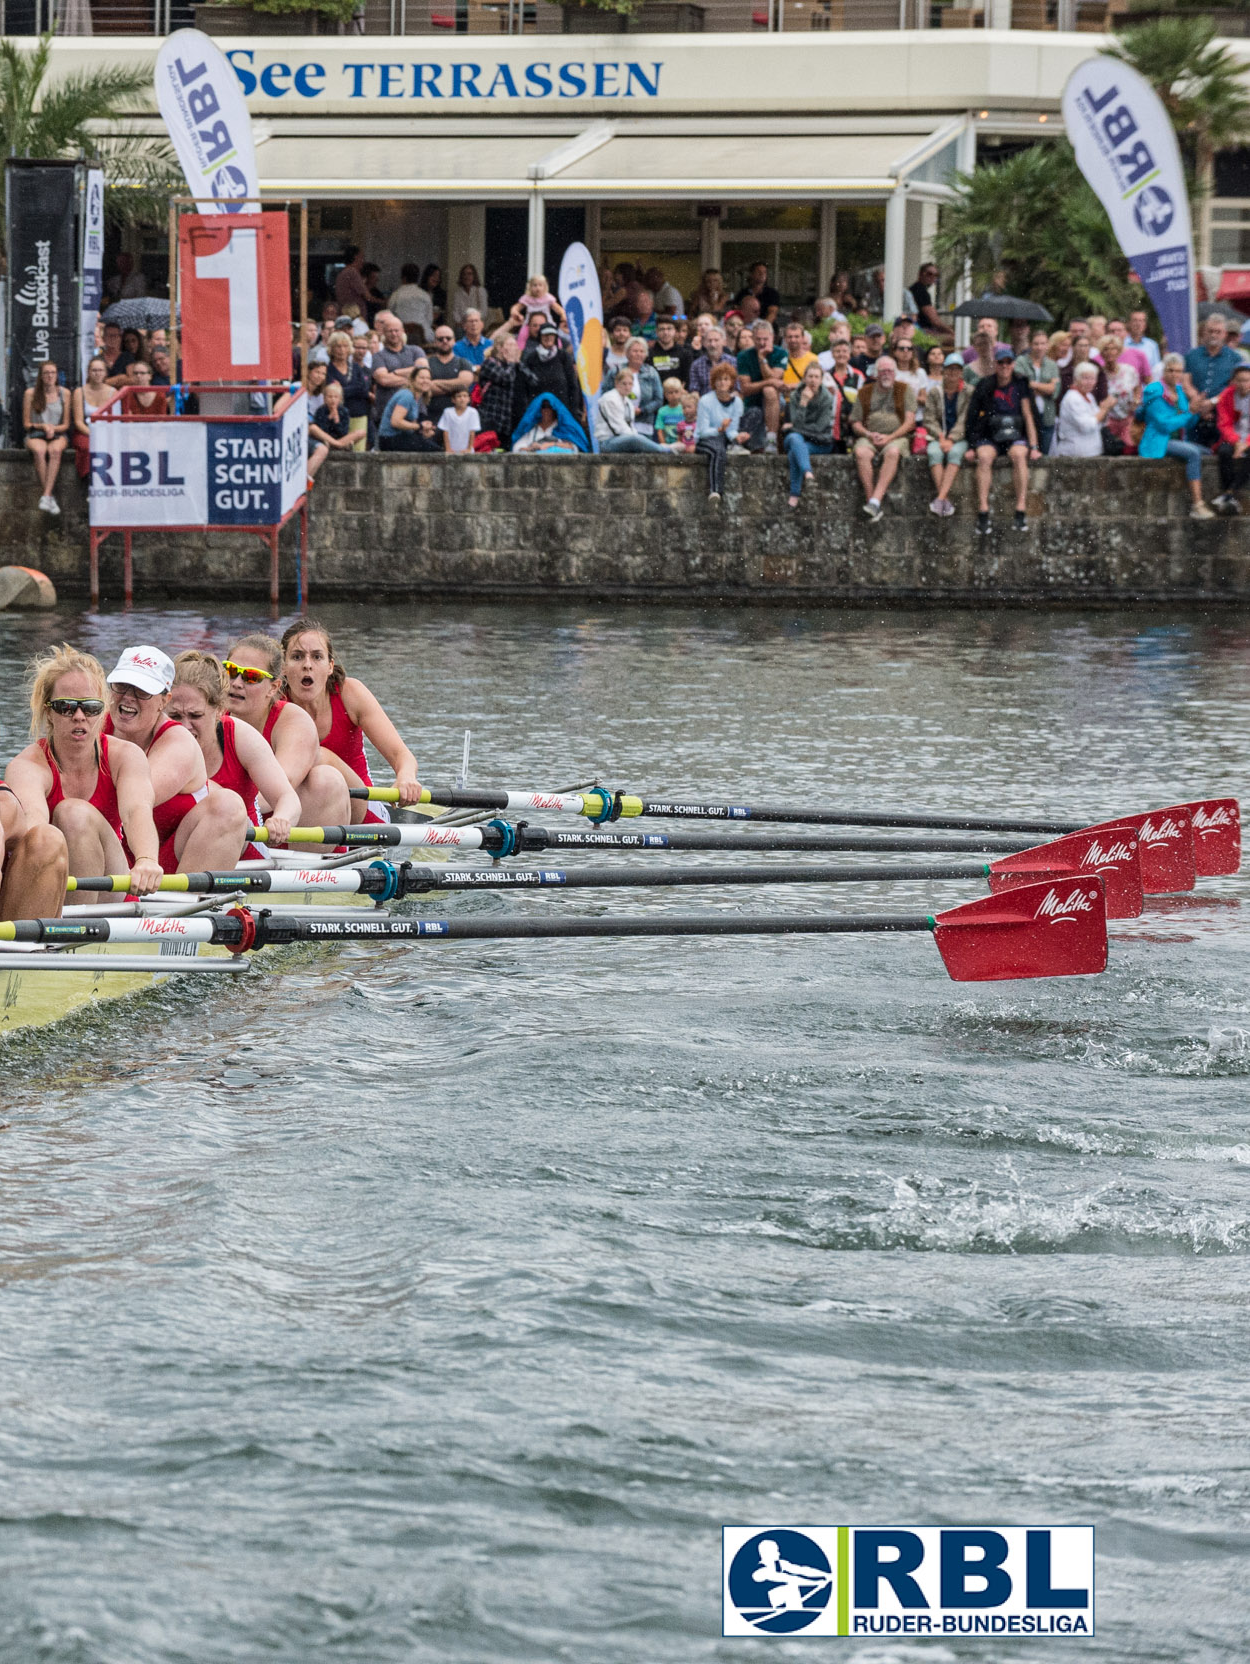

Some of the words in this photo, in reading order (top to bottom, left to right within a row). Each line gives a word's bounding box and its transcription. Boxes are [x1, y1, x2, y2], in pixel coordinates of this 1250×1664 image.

[225, 50, 326, 98] See
[342, 62, 664, 98] TERRASSEN
[33, 240, 50, 328] Broadcast
[195, 228, 260, 365] 1
[33, 330, 49, 362] Live
[89, 451, 185, 486] RBL
[214, 464, 280, 484] SCHN
[215, 490, 269, 509] GUT.
[526, 792, 563, 810] Melitta
[649, 804, 673, 813] STARK.
[674, 805, 707, 815] SCHNELL.
[708, 806, 725, 815] GUT.
[733, 808, 746, 816] RBL
[1192, 806, 1233, 828] Melitta
[421, 826, 461, 845] Melitta
[558, 833, 584, 843] STARK.
[585, 834, 621, 844] SCHNELL.
[622, 835, 640, 844] GUT.
[1138, 818, 1182, 842] Melitta
[1080, 840, 1133, 869] Melitta
[293, 869, 339, 884] Melitta
[445, 872, 474, 881] STARK.
[475, 872, 514, 882] SCHNELL.
[515, 872, 536, 881] GUT.
[545, 872, 561, 880] RBL
[1034, 888, 1093, 919] Melitta
[134, 917, 187, 935] Melitta
[310, 923, 344, 933] STARK.
[345, 923, 389, 933] SCHNELL.
[391, 923, 413, 933] GUT.
[425, 922, 443, 931] RBL
